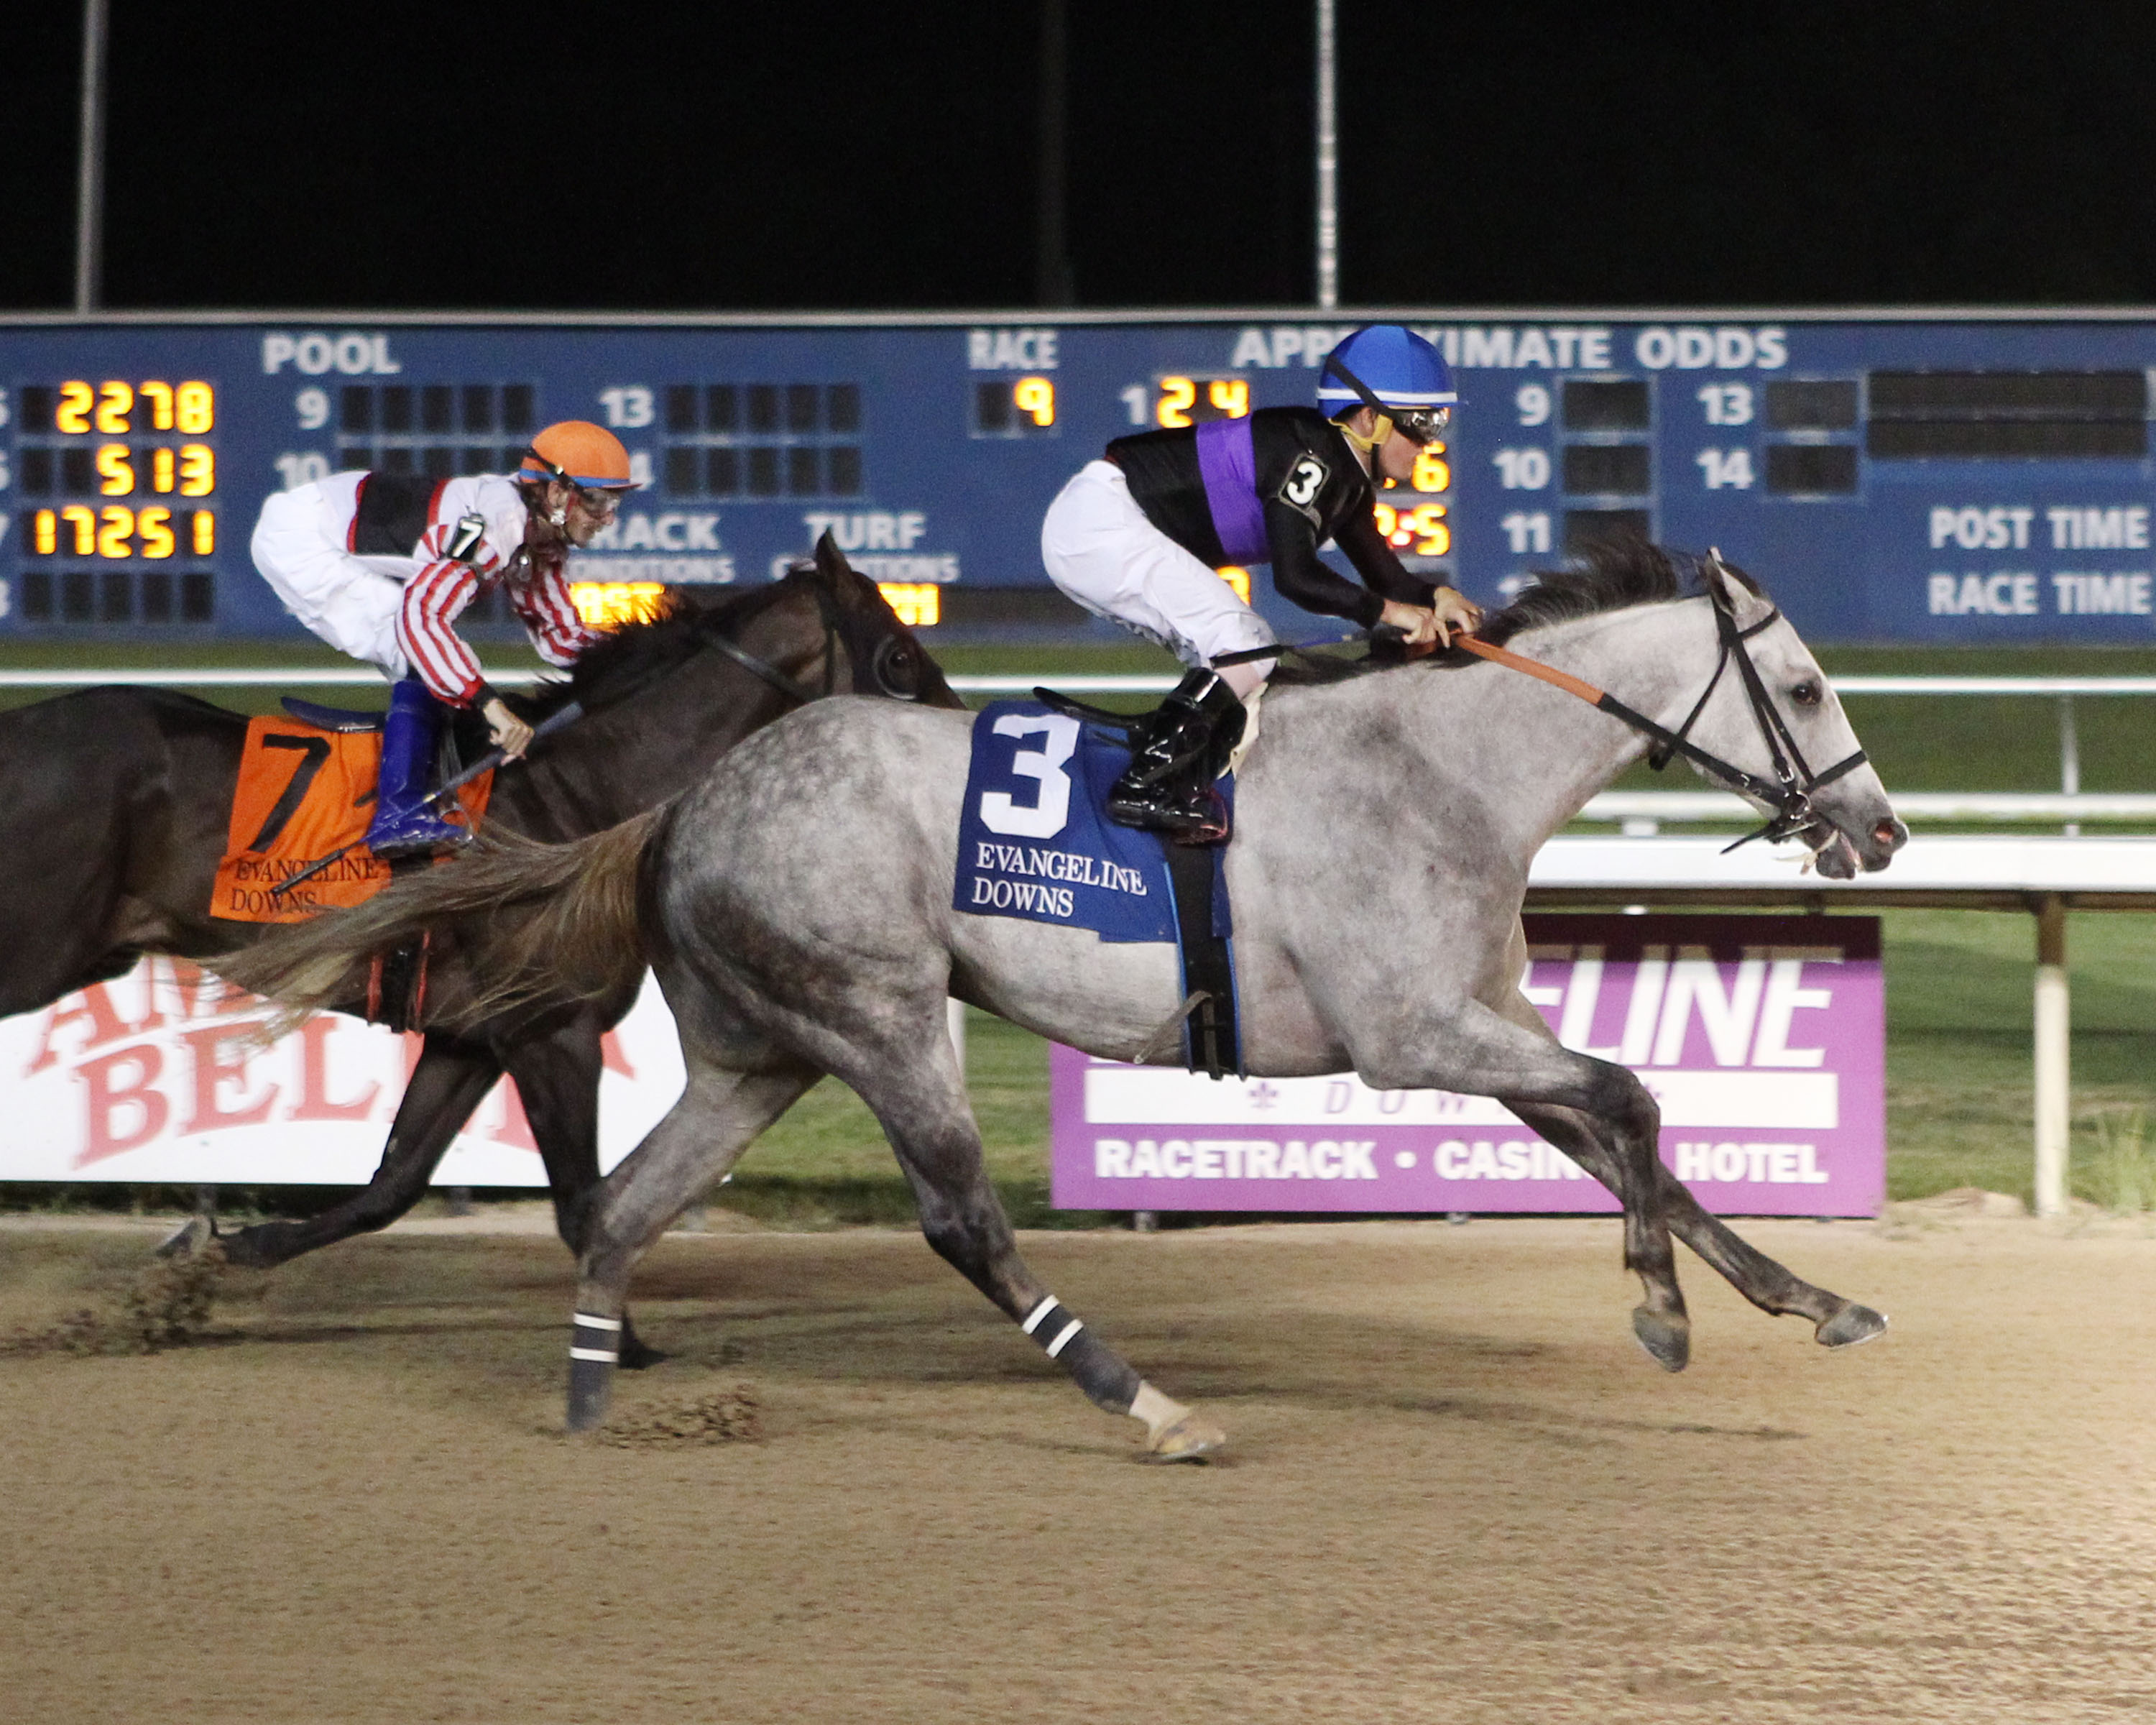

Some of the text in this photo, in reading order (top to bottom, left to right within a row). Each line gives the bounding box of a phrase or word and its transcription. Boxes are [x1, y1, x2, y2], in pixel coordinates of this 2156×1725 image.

[262, 334, 400, 374] POOL
[969, 332, 1058, 369] RACE
[1636, 330, 1788, 369] ODDS
[57, 381, 213, 433] 2278
[296, 387, 328, 429] 9
[601, 388, 653, 428] 13
[1015, 377, 1055, 427] 9
[1120, 386, 1148, 426] 1
[1516, 386, 1550, 426] 9
[1700, 386, 1754, 426] 13
[96, 443, 215, 497] 513
[1286, 461, 1323, 505] 3
[1494, 450, 1550, 490] 10
[1698, 451, 1754, 489] 14
[34, 506, 215, 558] 17251
[452, 519, 484, 558] 7
[804, 514, 926, 549] TURF
[1502, 514, 1549, 553] 11
[1930, 510, 2150, 549] POST TIME
[1930, 575, 2152, 615] RACE TIME
[249, 733, 331, 852] 7
[980, 714, 1080, 840] 3
[975, 842, 1148, 896] EVANGELINE
[972, 877, 1074, 918] DOWNS
[1095, 1139, 1829, 1183] RACETRACK CASIN HOTEL
